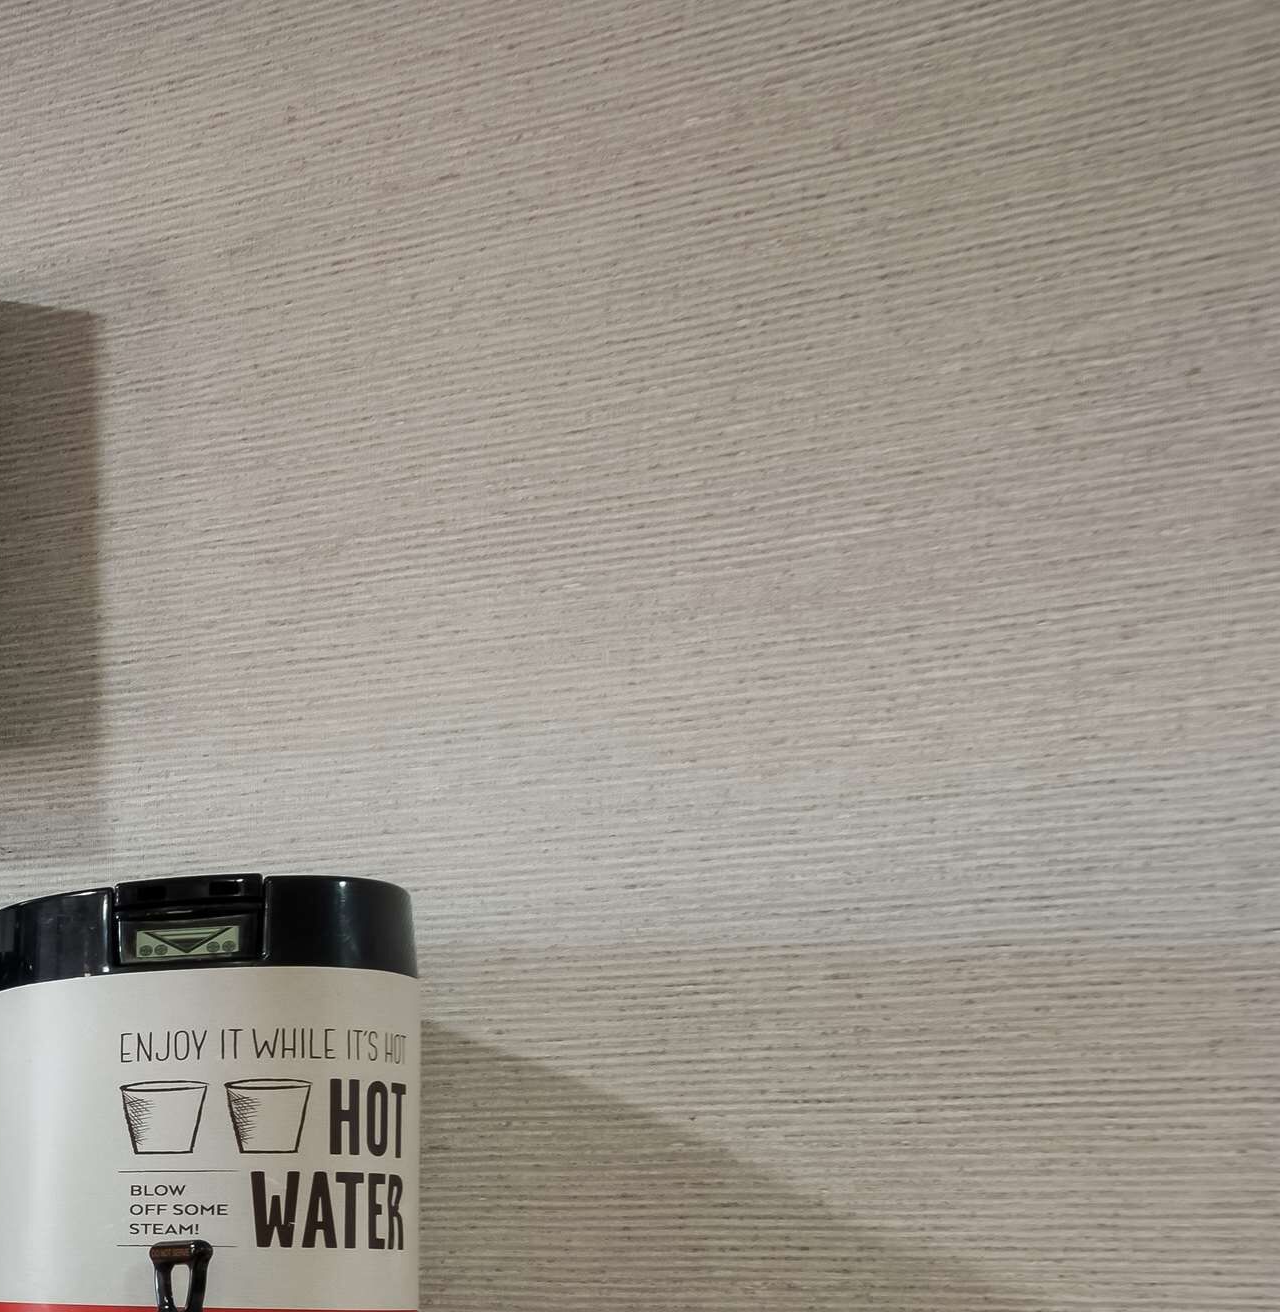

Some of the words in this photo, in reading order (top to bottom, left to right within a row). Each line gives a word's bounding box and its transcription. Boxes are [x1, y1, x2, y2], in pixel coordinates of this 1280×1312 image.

[120, 1029, 206, 1064] ENJOY
[220, 1029, 244, 1060] IT
[253, 1028, 335, 1060] WHILE
[347, 1029, 379, 1062] IT'S
[384, 1034, 407, 1066] HOT
[329, 1078, 407, 1159] HOT
[130, 1184, 186, 1197] BLOW
[130, 1203, 168, 1216] OFF
[173, 1203, 228, 1216] SOME
[251, 1170, 405, 1251] WATER
[129, 1223, 199, 1236] STEAM!
